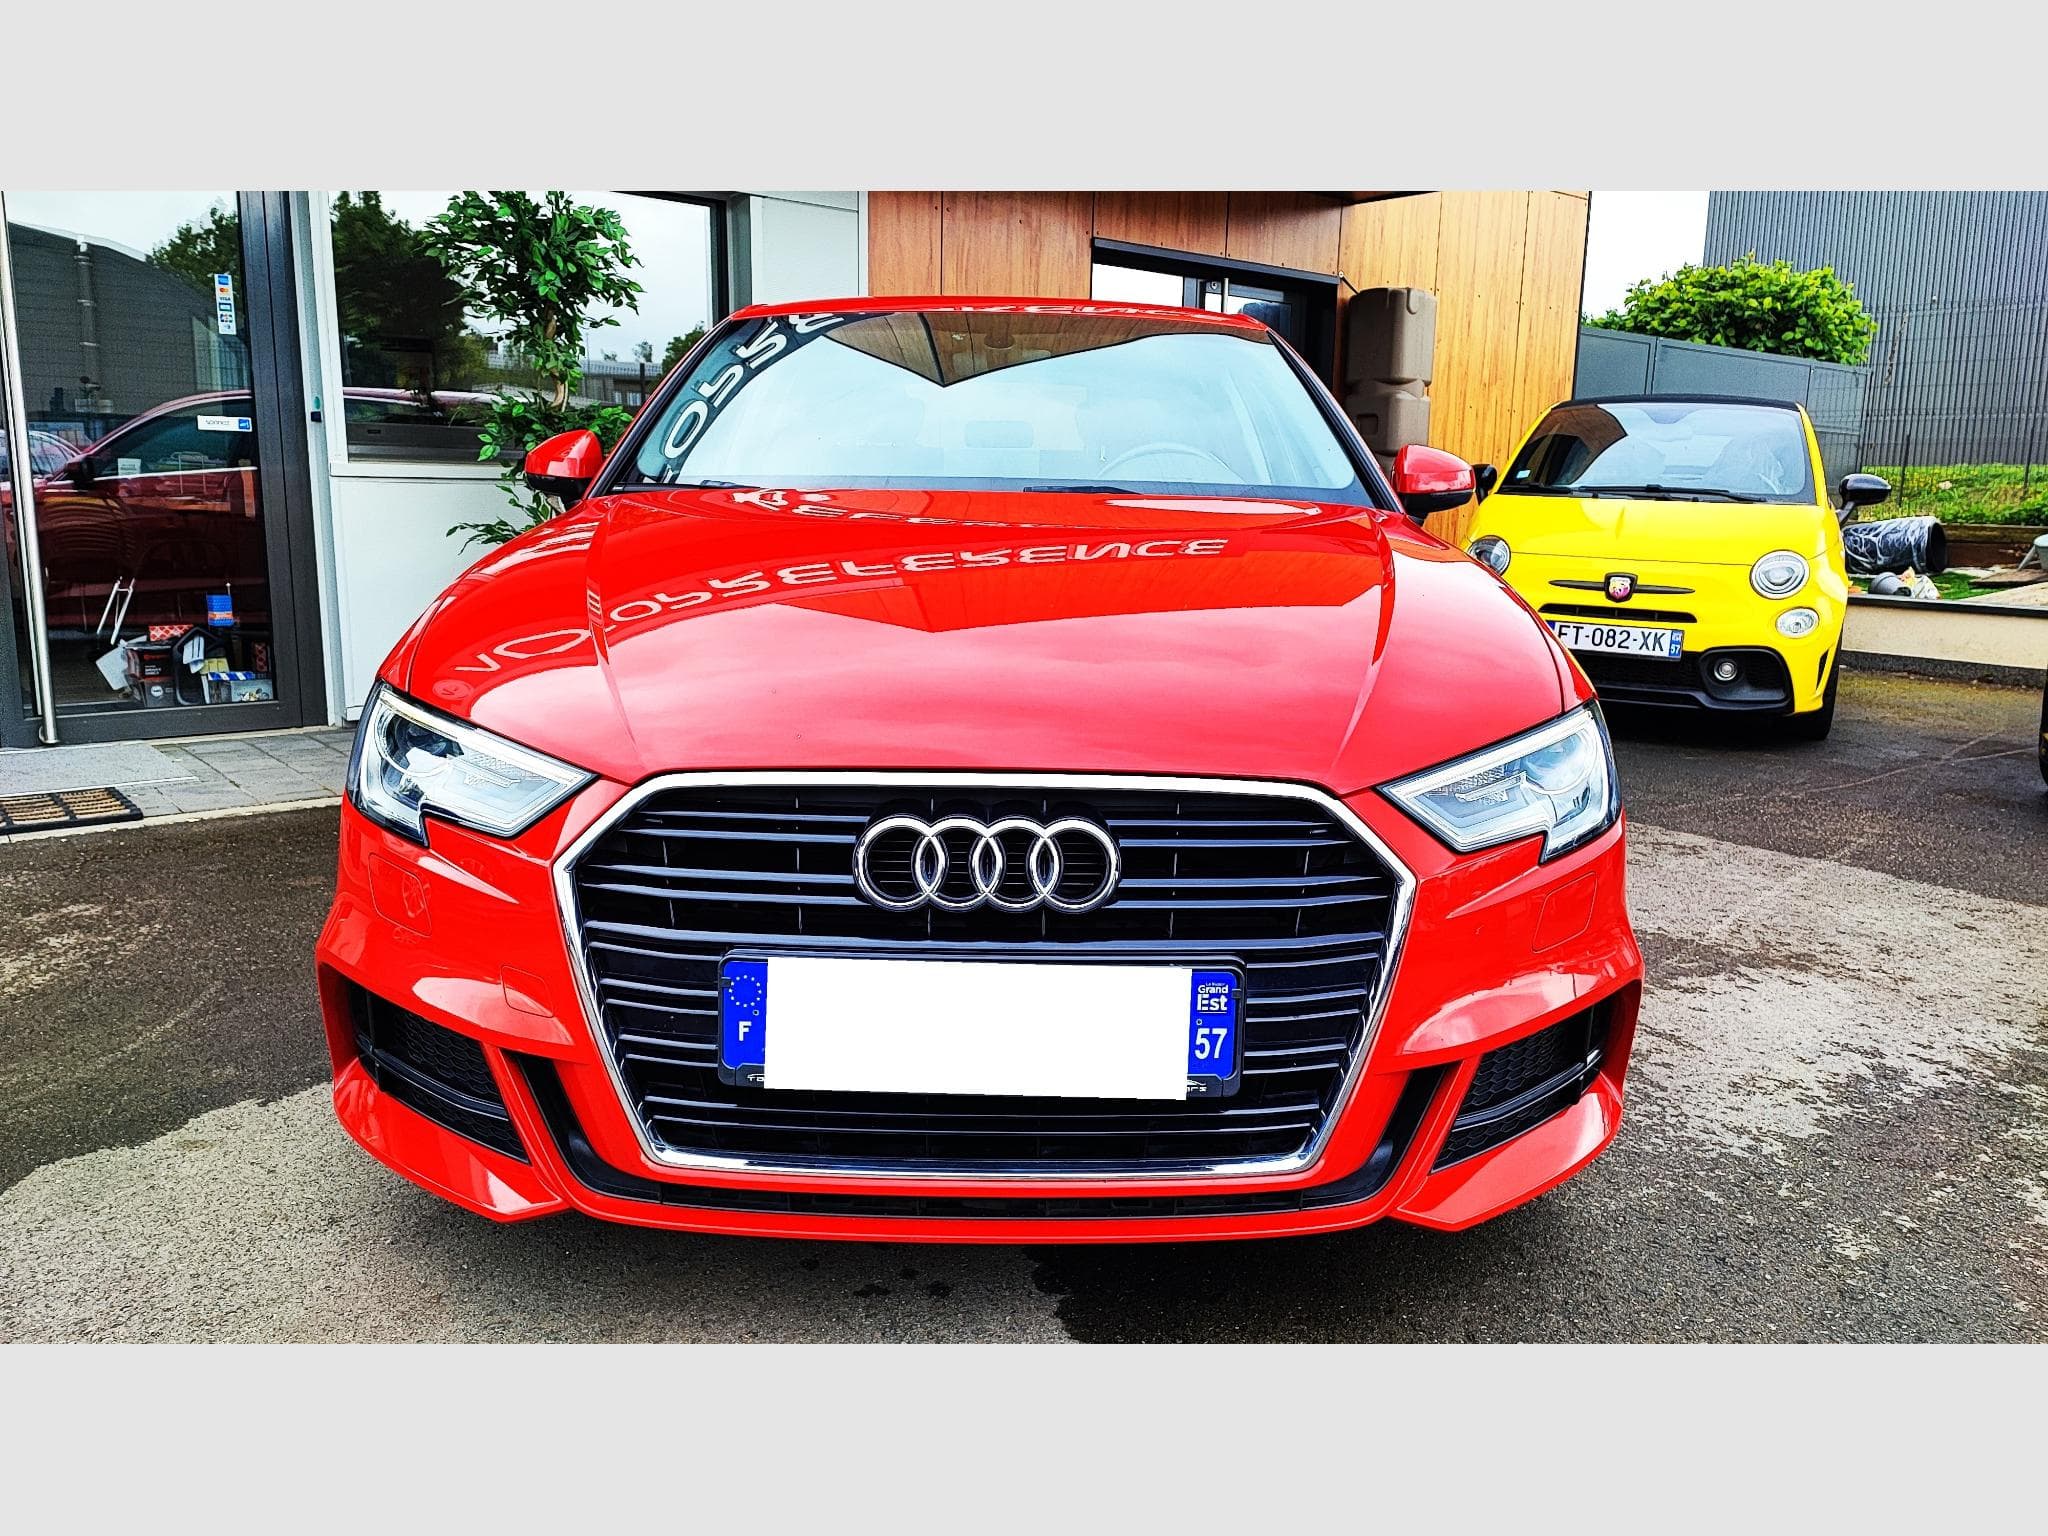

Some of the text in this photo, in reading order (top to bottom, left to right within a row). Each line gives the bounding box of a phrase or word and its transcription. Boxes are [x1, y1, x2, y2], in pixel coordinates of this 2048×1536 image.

[1557, 624, 1666, 652] FT-082-XK
[1670, 643, 1681, 654] 57
[1197, 984, 1229, 994] Grand
[1196, 993, 1228, 1011] Est
[738, 1021, 752, 1042] F
[1194, 1027, 1228, 1060] 57
